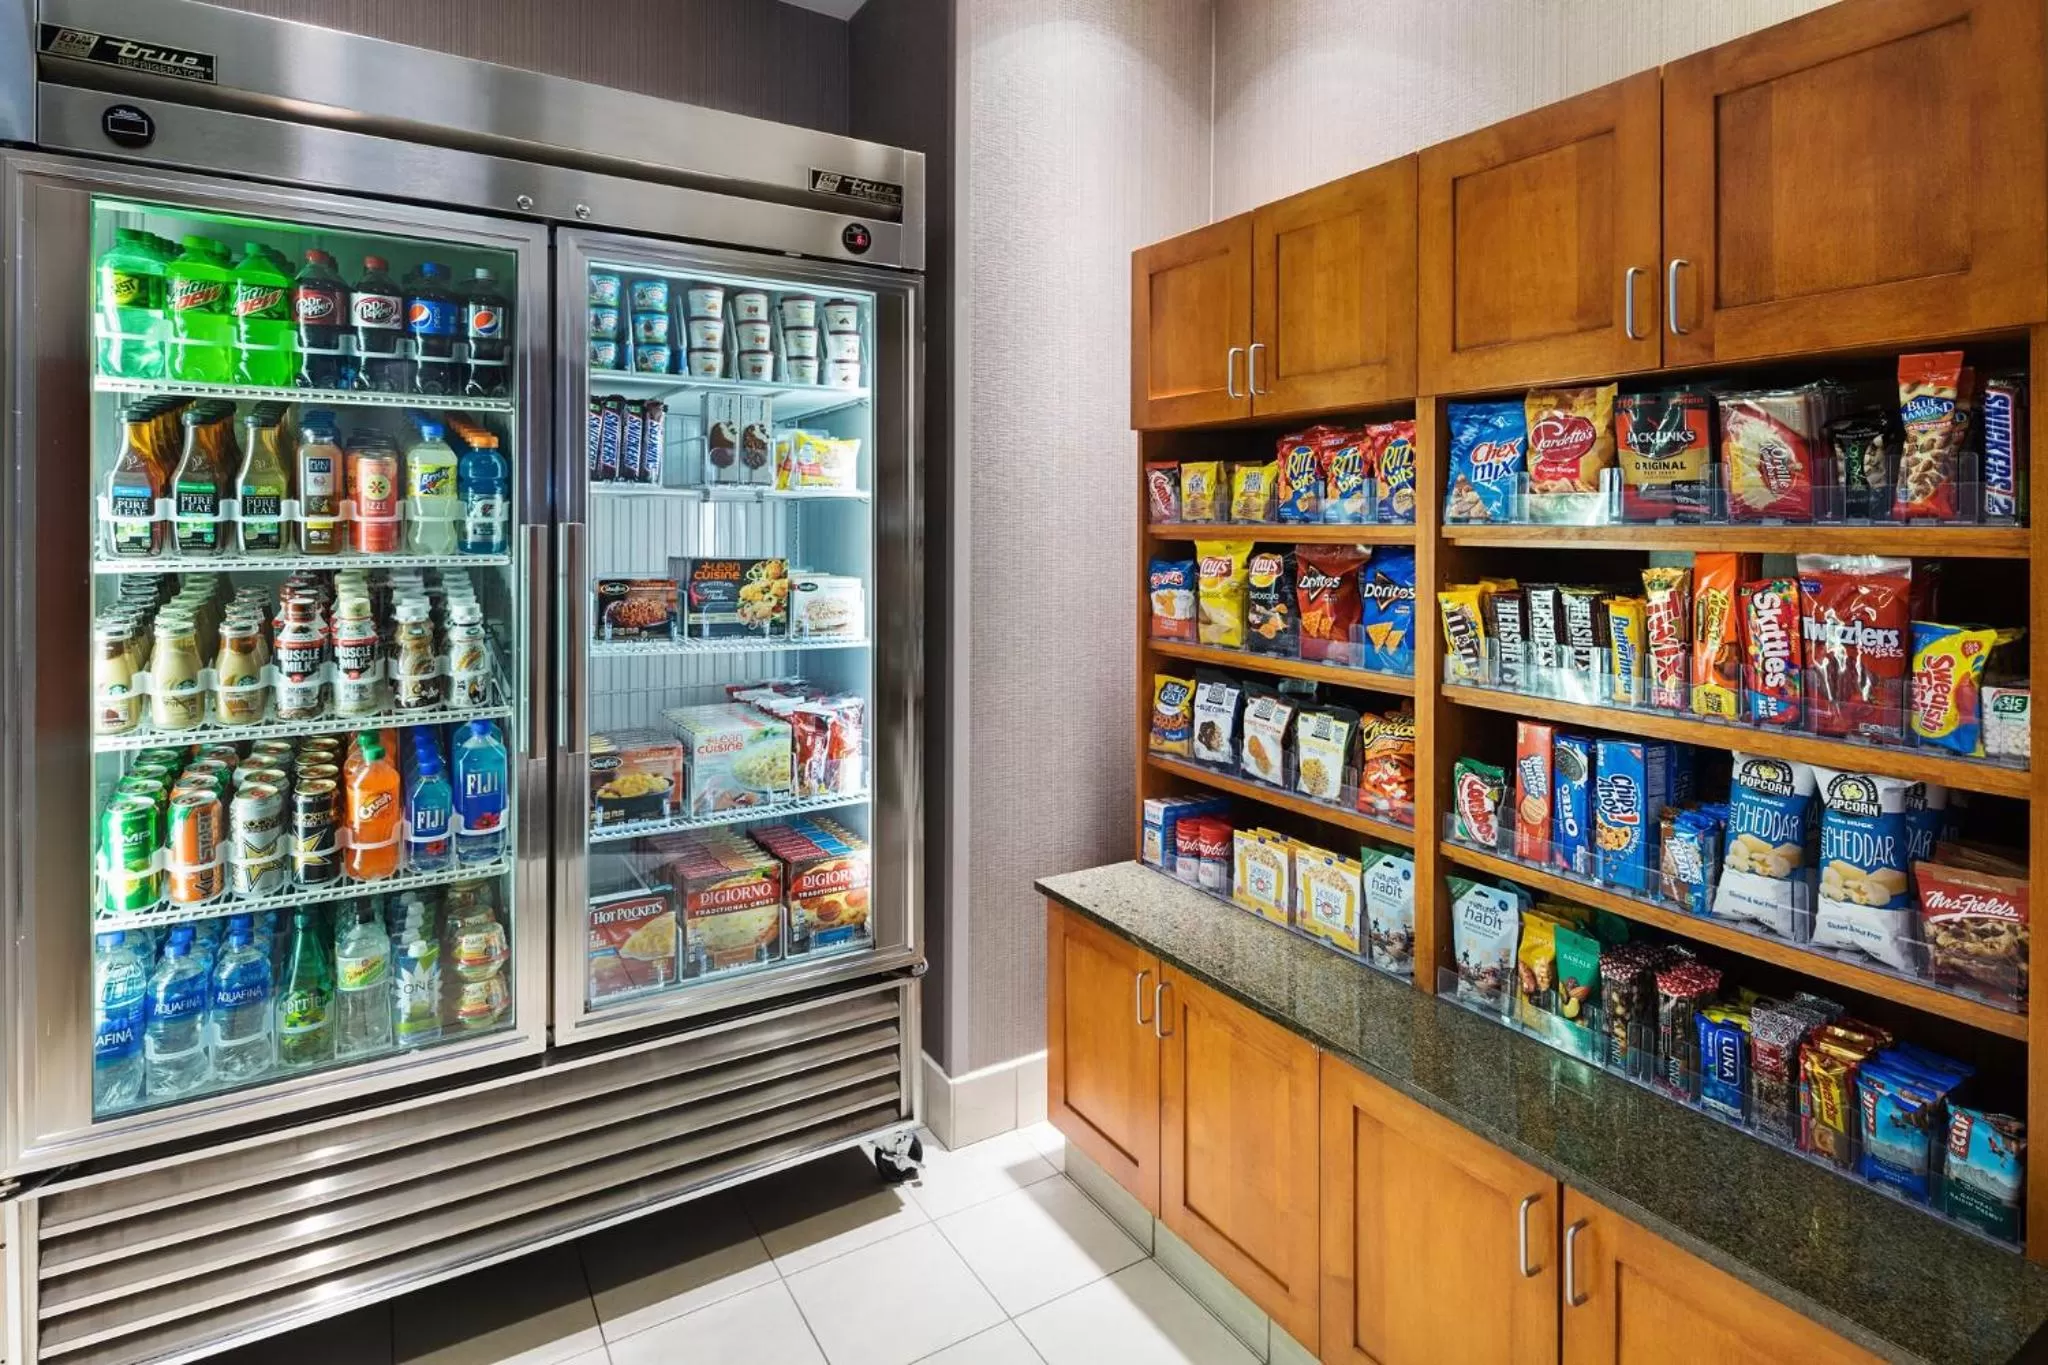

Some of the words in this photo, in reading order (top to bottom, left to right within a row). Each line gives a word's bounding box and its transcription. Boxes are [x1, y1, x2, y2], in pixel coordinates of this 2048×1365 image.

[105, 40, 205, 71] true
[118, 57, 205, 79] REFRIGERATOR
[299, 302, 331, 316] Pepper
[307, 297, 321, 306] Dr
[359, 303, 393, 319] Pepper
[372, 301, 386, 313] Dr
[1906, 398, 1937, 411] BLUE
[602, 411, 619, 466] SNICKERS
[624, 415, 642, 469] SNICKERS
[1627, 430, 1654, 444] JACK
[1985, 394, 2012, 494] SNICKERS
[1381, 444, 1413, 476] RITZ
[1471, 438, 1523, 464] Chex
[1287, 452, 1315, 479] RITZ
[1331, 454, 1361, 478] RITZ
[1387, 466, 1414, 487] bits
[1472, 461, 1517, 483] mix
[1635, 460, 1687, 471] ORIGINAL
[1770, 447, 1792, 489] Orville
[1291, 472, 1316, 490] bits
[118, 500, 148, 510] PURE
[181, 494, 213, 505] PURE
[181, 504, 212, 513] LEAF
[246, 498, 276, 508] PURE
[246, 507, 276, 515] LEAF
[1200, 558, 1232, 577] Lay's
[1251, 558, 1280, 574] Lay's
[1299, 575, 1341, 589] Doritos
[1363, 583, 1416, 599] Doritos
[1531, 589, 1557, 667] HERSHEY'S
[1647, 589, 1684, 683] TWIX
[1803, 616, 1899, 648] Twizzlers
[1497, 598, 1523, 686] HERSHEY'S
[1752, 591, 1790, 688] Skittles
[278, 648, 320, 662] MUSCLE
[335, 645, 371, 659] MUSCLE
[1611, 615, 1633, 694] Butterfinger
[1857, 645, 1904, 658] twists
[284, 659, 311, 673] MILK
[340, 658, 366, 670] MILK
[1921, 654, 1955, 732] Swedish
[2001, 696, 2024, 704] tic
[2000, 703, 2023, 712] tac
[466, 771, 498, 795] FIJI
[1520, 759, 1540, 800] Butter
[1530, 755, 1548, 795] Nutter
[1740, 775, 1792, 797] POPCORN
[358, 792, 392, 820] Crush
[1610, 775, 1637, 816] Chips
[417, 809, 445, 829] FIJI
[1561, 784, 1579, 838] OREO
[1736, 802, 1799, 841] CHEDDAR
[1826, 826, 1897, 867] CHEDDAR
[700, 882, 772, 905] DIGIORNO
[798, 885, 847, 898] TRADITIONAL
[1371, 876, 1403, 899] habit
[593, 911, 616, 925] HOT
[617, 901, 663, 920] POCKETS
[694, 903, 749, 916] TRADITIONAL
[750, 897, 775, 909] CRUST
[1959, 894, 2019, 917] Fields
[1464, 906, 1504, 931] habit
[153, 995, 202, 1016] AQUAFINA
[217, 986, 264, 1003] AQUAFINA
[1611, 1036, 1621, 1065] KIND
[1722, 1036, 1735, 1078] LUNA
[1669, 1055, 1681, 1088] KIND
[1951, 1114, 1972, 1146] CLIF
